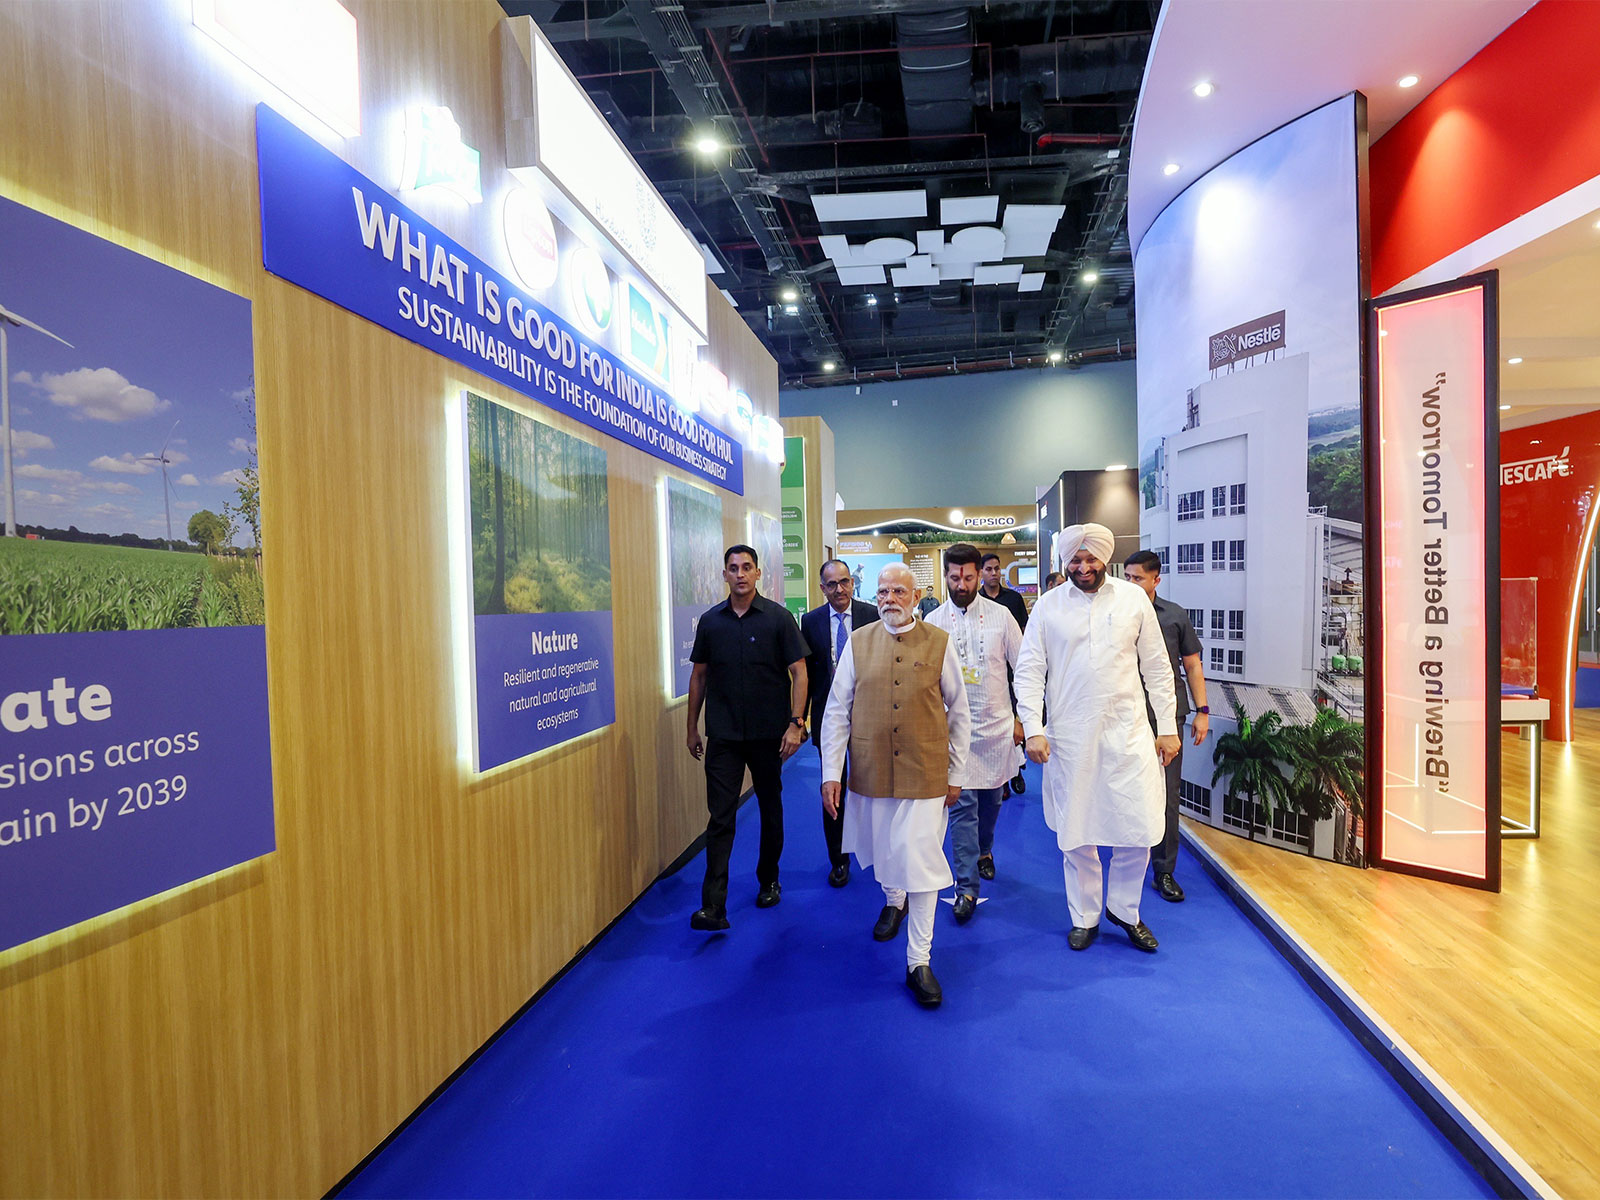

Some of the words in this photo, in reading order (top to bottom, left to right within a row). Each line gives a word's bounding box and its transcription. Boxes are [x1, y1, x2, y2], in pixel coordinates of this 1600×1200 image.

[352, 186, 469, 305] WHAT
[475, 271, 502, 325] IS
[506, 296, 577, 369] GOOD
[580, 342, 615, 395] FOR
[616, 367, 656, 419] INDIA
[656, 394, 668, 426] IS
[668, 404, 699, 445] GOOD
[699, 423, 717, 455] FOR
[717, 435, 735, 466] HUL
[398, 286, 542, 387] SUSTAINABILITY
[544, 367, 557, 395] IS
[558, 375, 582, 409] THE
[584, 389, 647, 441] FOUNDATION
[647, 426, 659, 447] OF
[659, 434, 676, 455] OUR
[676, 440, 703, 470] BUSINESS
[702, 455, 727, 481] STRATEGY
[964, 517, 1015, 527] PEPSICO
[531, 630, 579, 655] Nature
[503, 668, 541, 687] Resilient
[541, 664, 557, 680] and
[558, 657, 600, 679] regenerative
[0, 677, 112, 733] ate
[509, 691, 542, 713] natural
[542, 687, 558, 705] and
[558, 678, 597, 702] agricultural
[537, 708, 579, 731] ecosystems
[104, 731, 200, 768] across
[68, 797, 109, 832] by
[117, 774, 188, 816] 2039
